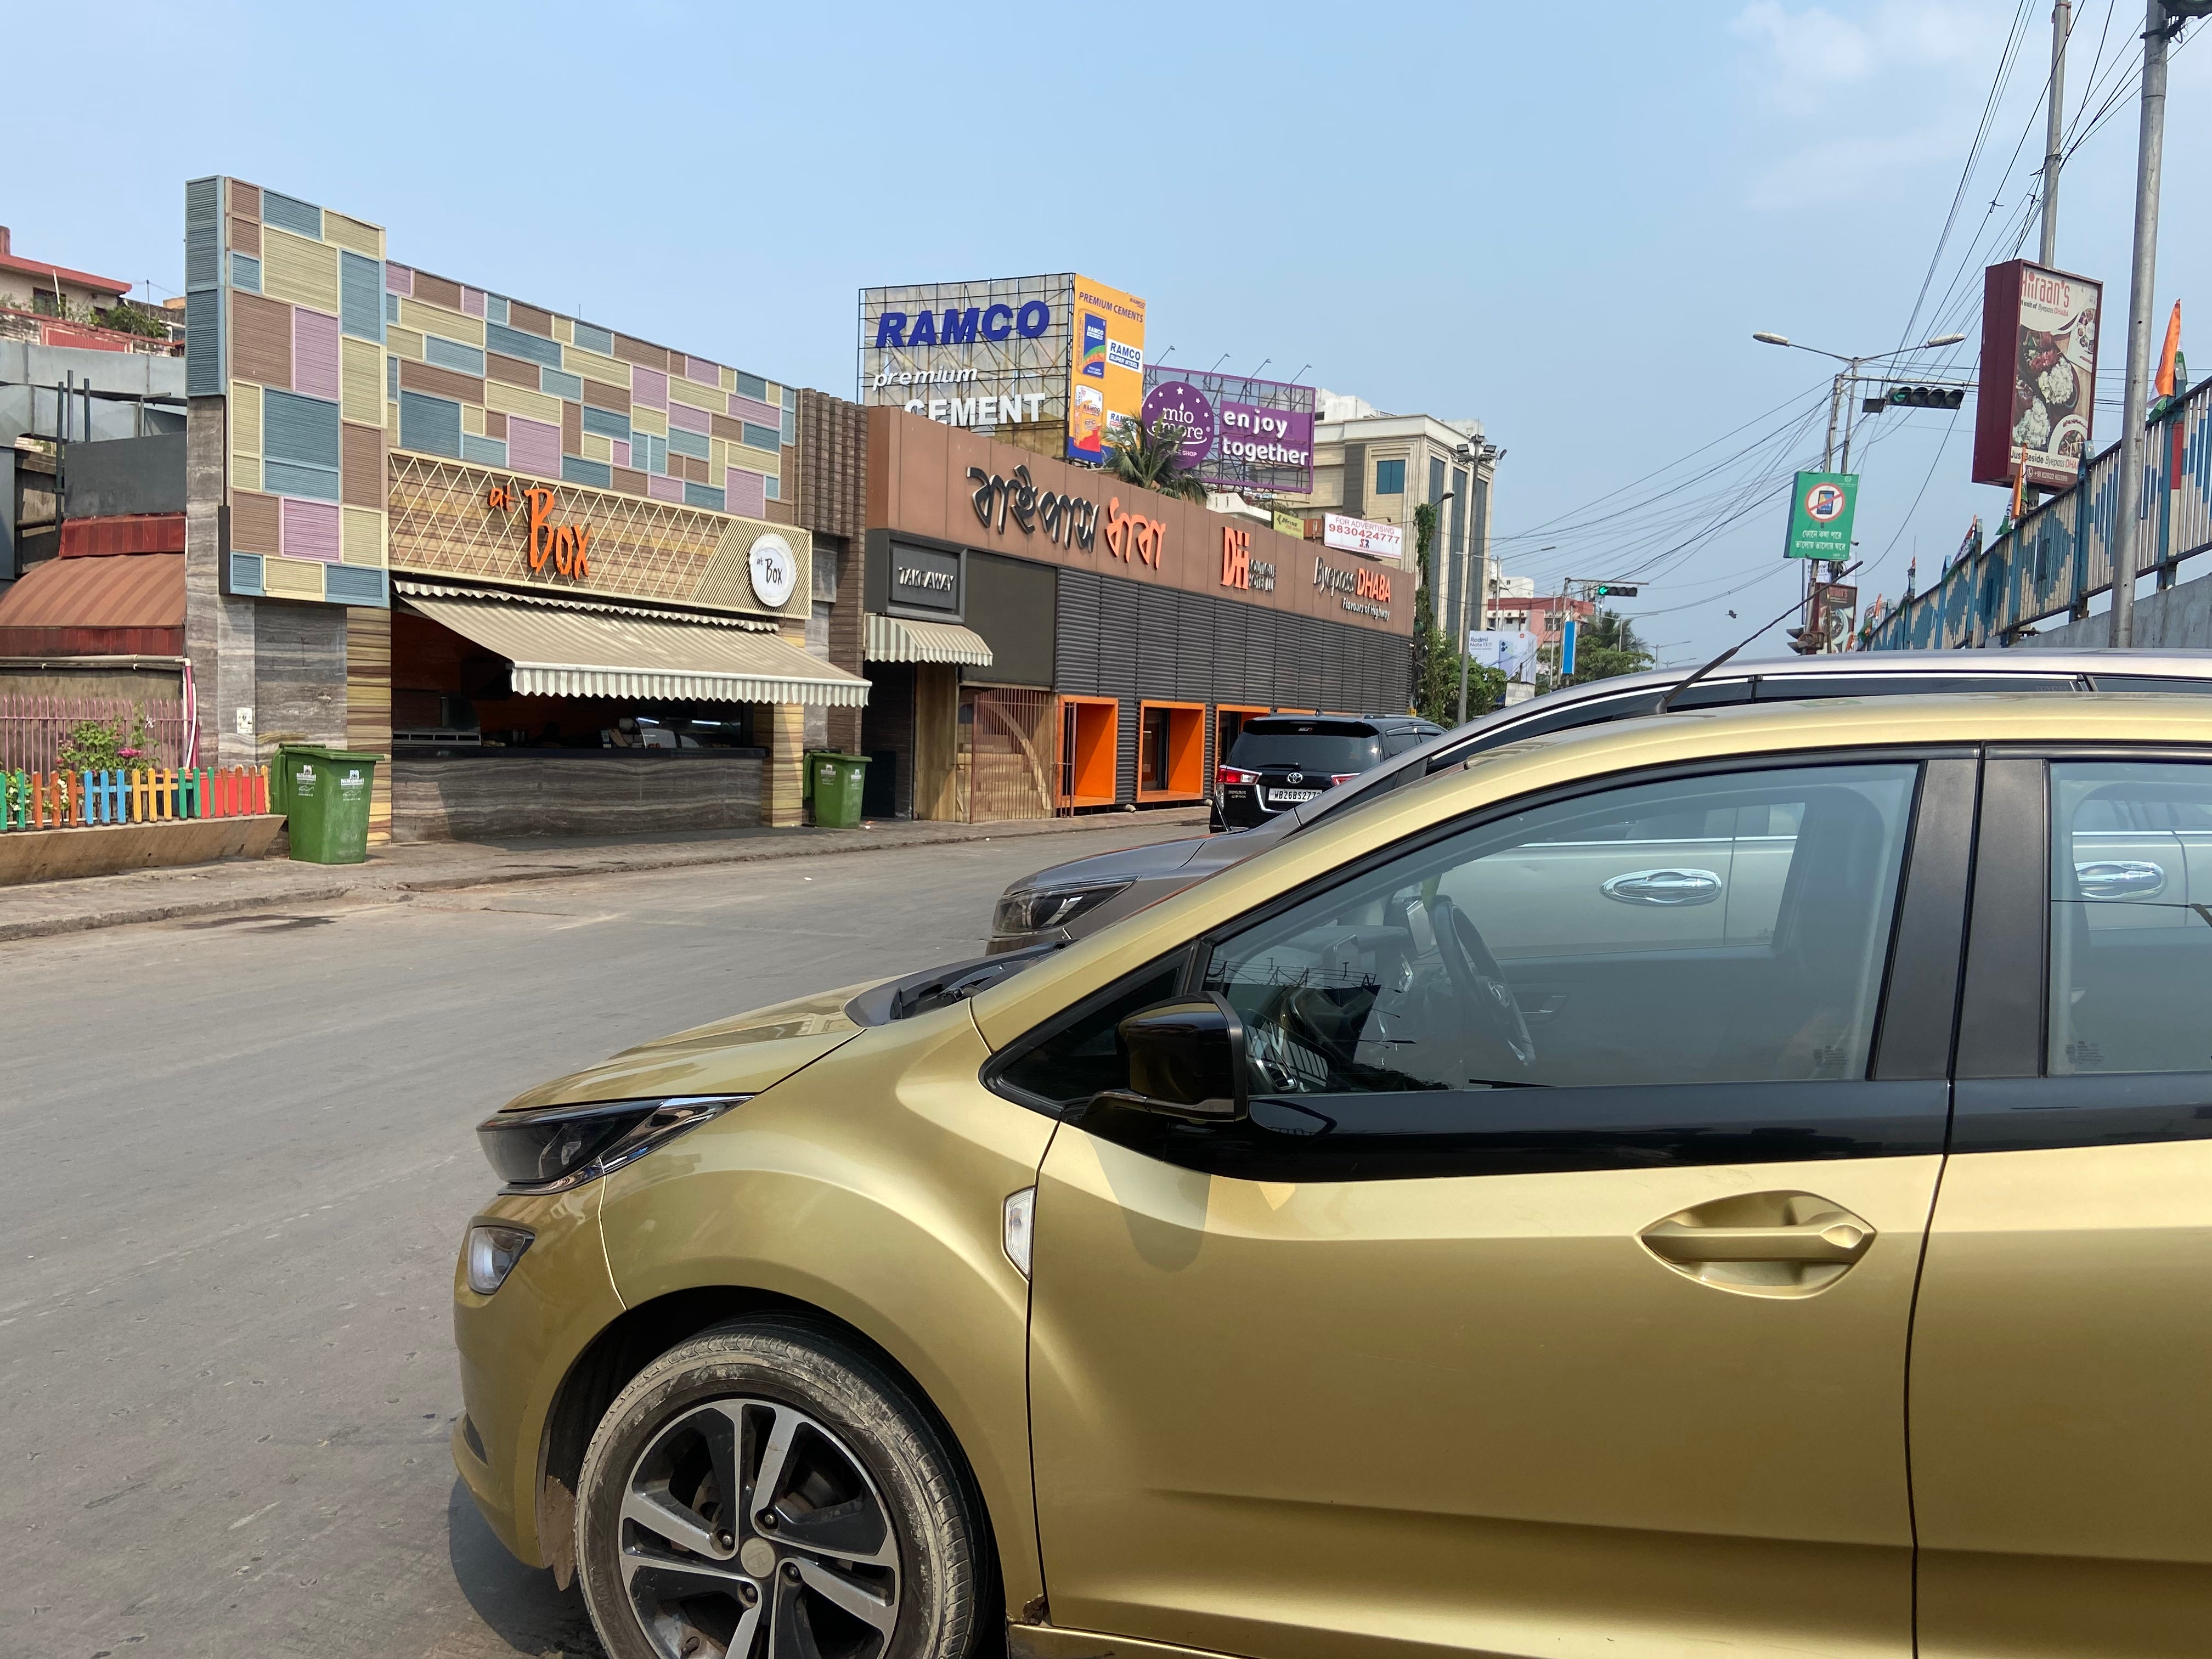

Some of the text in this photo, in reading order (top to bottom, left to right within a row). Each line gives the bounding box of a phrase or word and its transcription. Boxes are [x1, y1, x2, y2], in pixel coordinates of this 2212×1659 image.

[1079, 292, 1143, 323] PREMIUM CEMENTS
[876, 301, 1050, 347] RAMCO
[1087, 325, 1104, 336] RAMCO
[1110, 342, 1141, 361] RAMCO
[1110, 356, 1138, 368] SUPER STEEL
[872, 365, 978, 391] premium
[904, 393, 1046, 427] CEMENT
[1163, 402, 1194, 424] mio
[1223, 408, 1288, 438] enjoy
[1222, 436, 1309, 466] together
[2045, 455, 2065, 467] Byepass
[2066, 459, 2079, 470] DHA
[966, 465, 1100, 554] বাইপাস
[487, 484, 591, 580] at Box
[1329, 523, 1400, 544] 9830424777
[1335, 517, 1395, 534] FOR ADVERTISING
[765, 558, 783, 585] Box
[899, 567, 955, 591] TAKE AWAY
[1314, 556, 1391, 603] Byepass DHABA
[1342, 597, 1390, 621] Flavours of Highway
